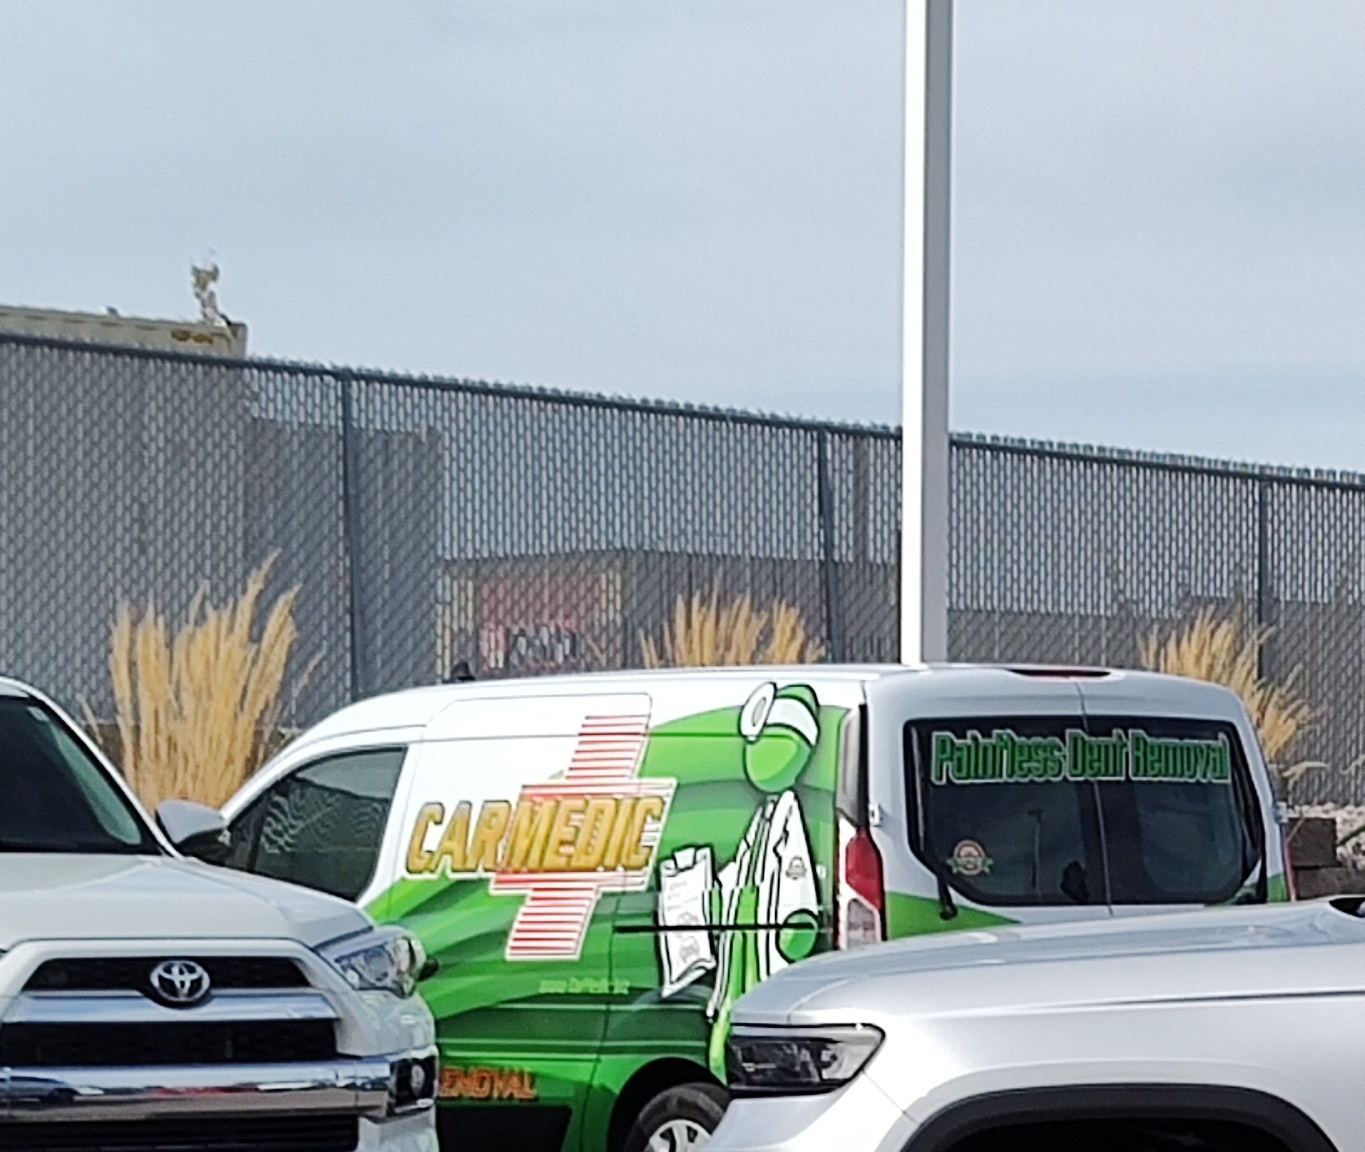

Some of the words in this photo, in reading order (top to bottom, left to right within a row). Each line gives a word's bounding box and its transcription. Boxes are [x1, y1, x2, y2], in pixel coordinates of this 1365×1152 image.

[931, 729, 1064, 785] Painless
[1065, 728, 1128, 782] Dent
[1128, 728, 1231, 784] Removal
[405, 795, 664, 874] CARMEDIC
[437, 1067, 539, 1100] EMOVAL
